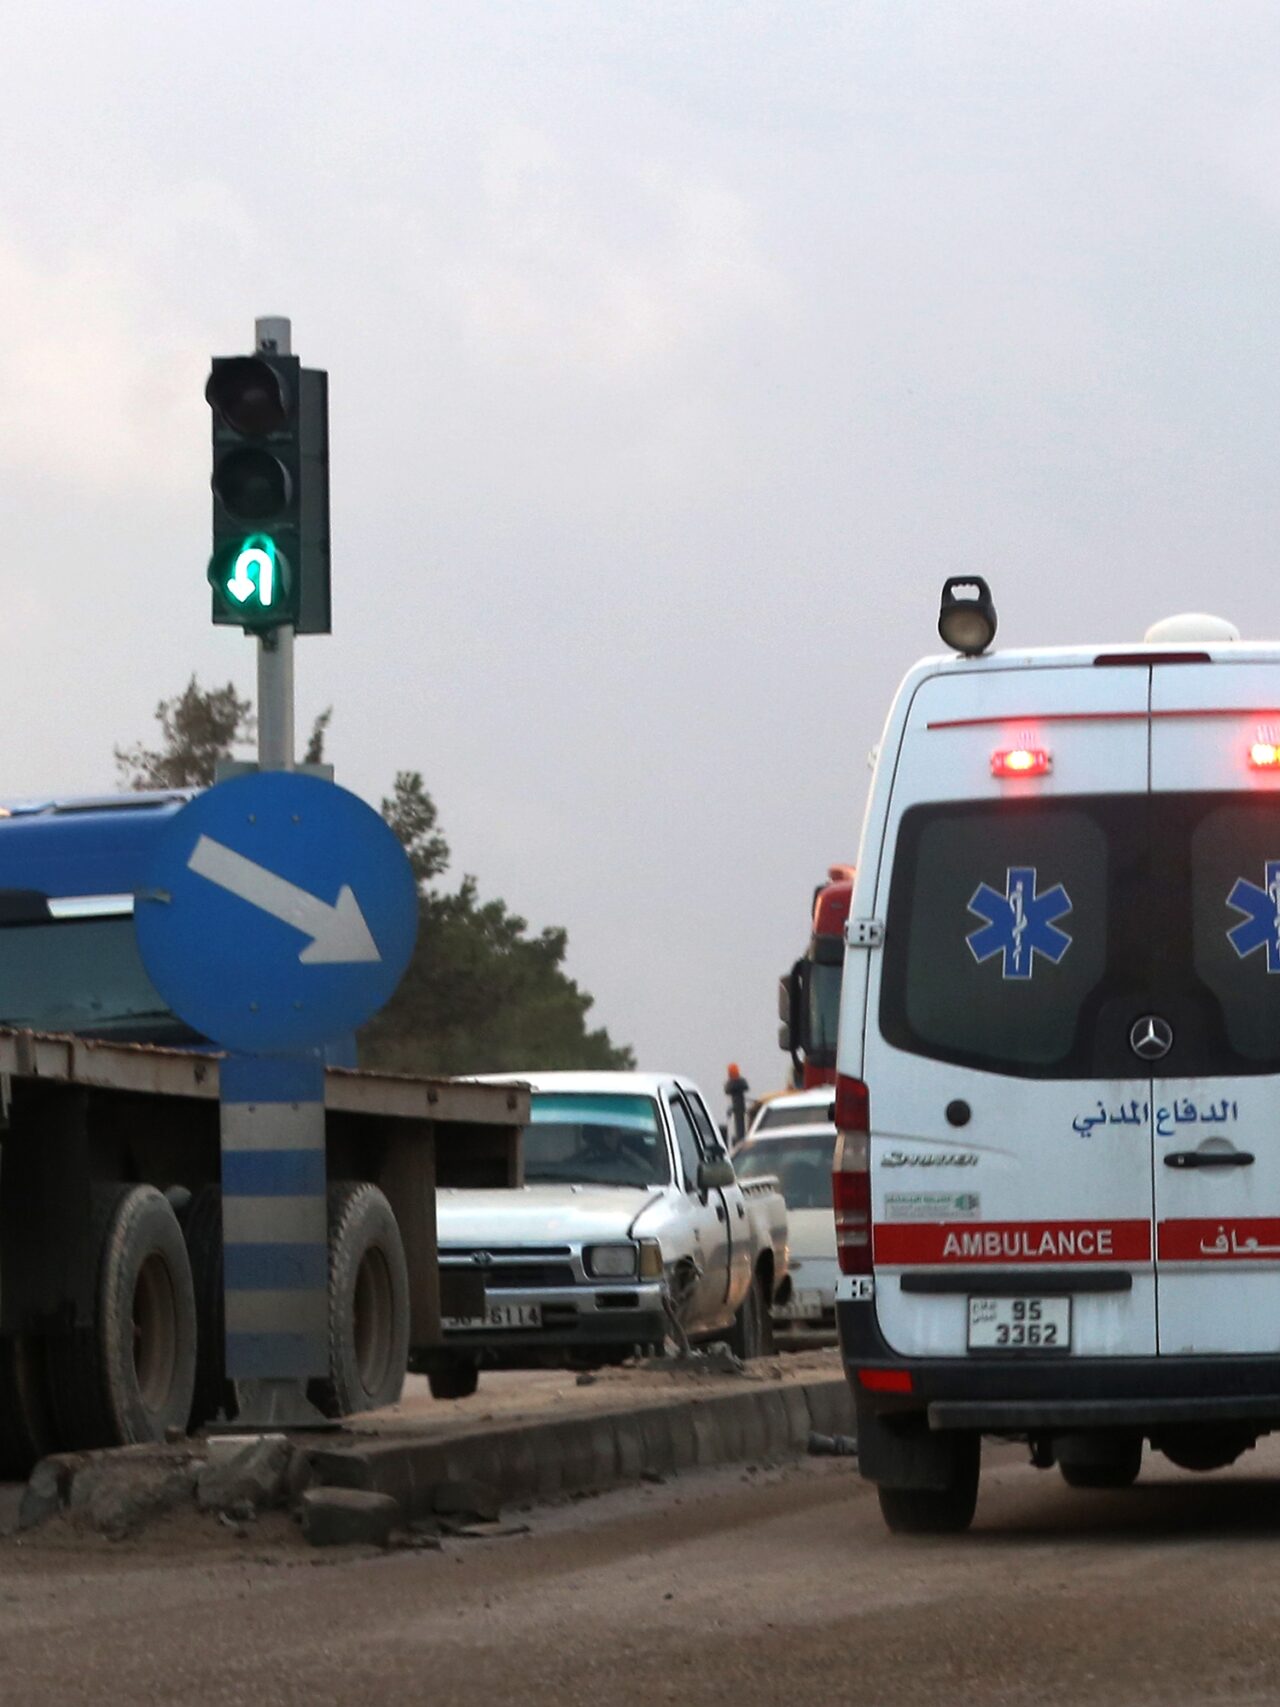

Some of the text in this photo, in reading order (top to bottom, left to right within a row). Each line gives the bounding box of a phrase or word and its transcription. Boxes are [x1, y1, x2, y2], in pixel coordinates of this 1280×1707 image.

[1072, 1098, 1239, 1138] الدفاع المدني
[942, 1228, 1114, 1258] AMBULANCE
[1012, 1300, 1042, 1321] 95
[996, 1323, 1058, 1345] 3362
